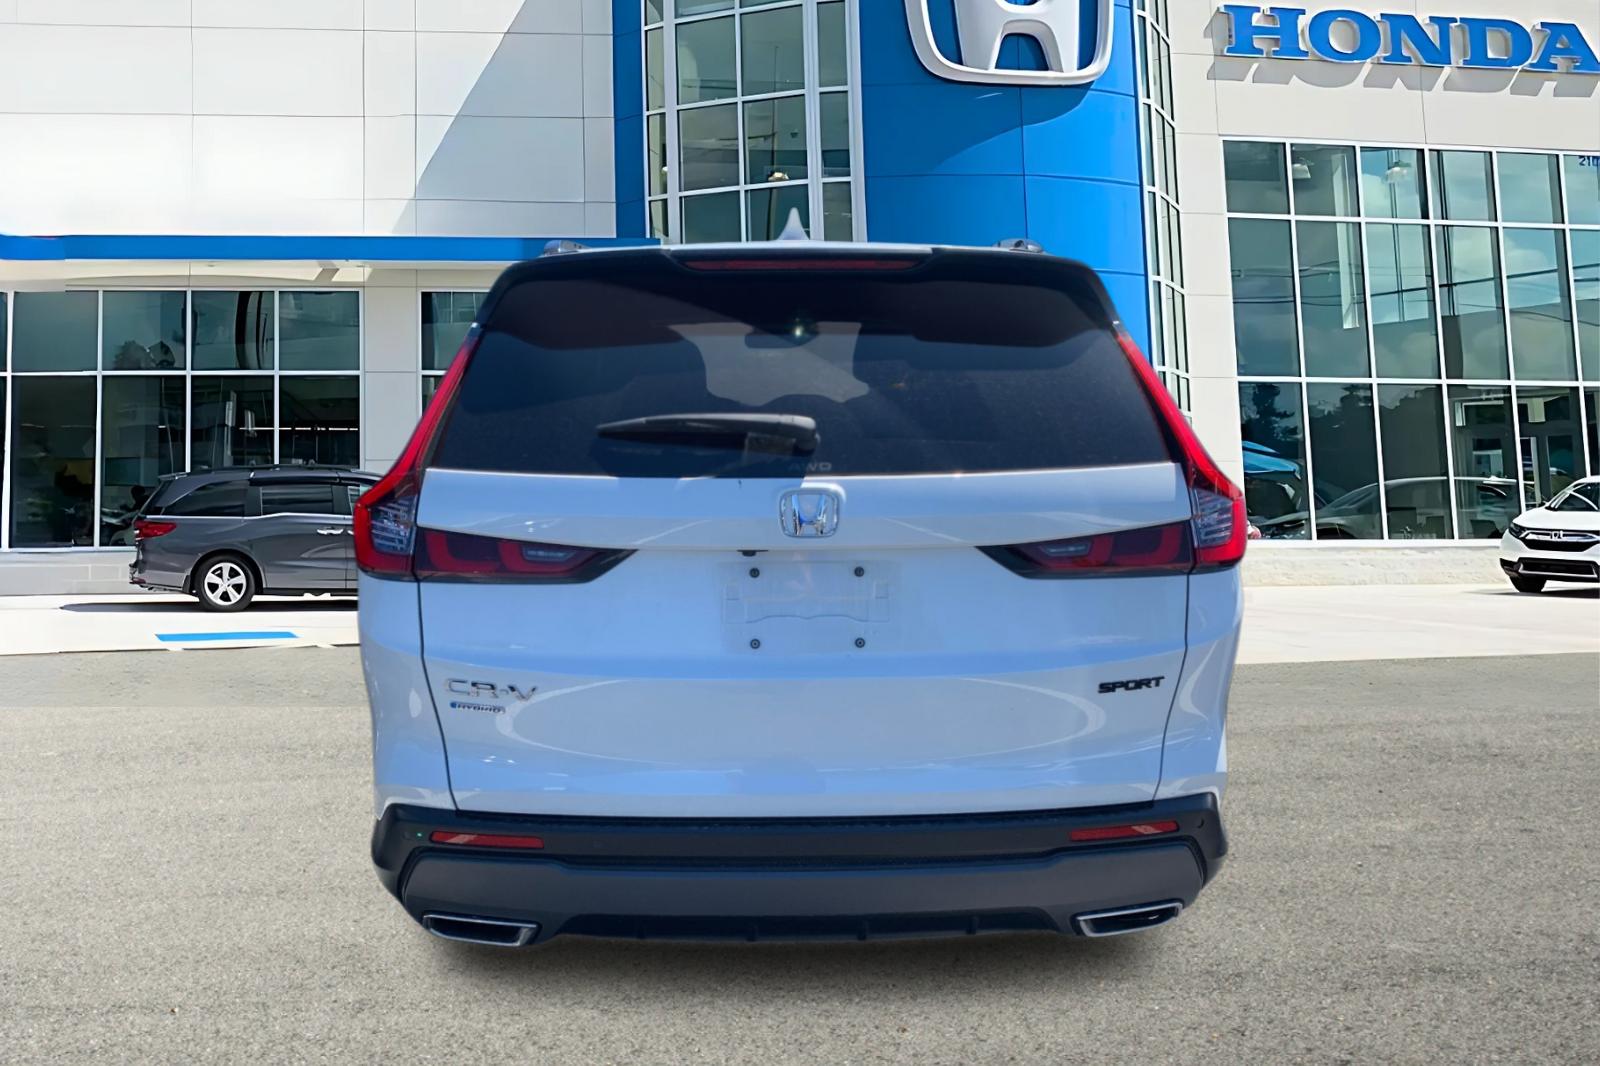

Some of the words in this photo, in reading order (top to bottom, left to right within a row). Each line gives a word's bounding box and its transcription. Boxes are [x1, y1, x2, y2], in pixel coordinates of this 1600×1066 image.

[1221, 4, 1600, 73] HONDA
[447, 678, 537, 701] CR-V
[1098, 676, 1165, 694] SPORT
